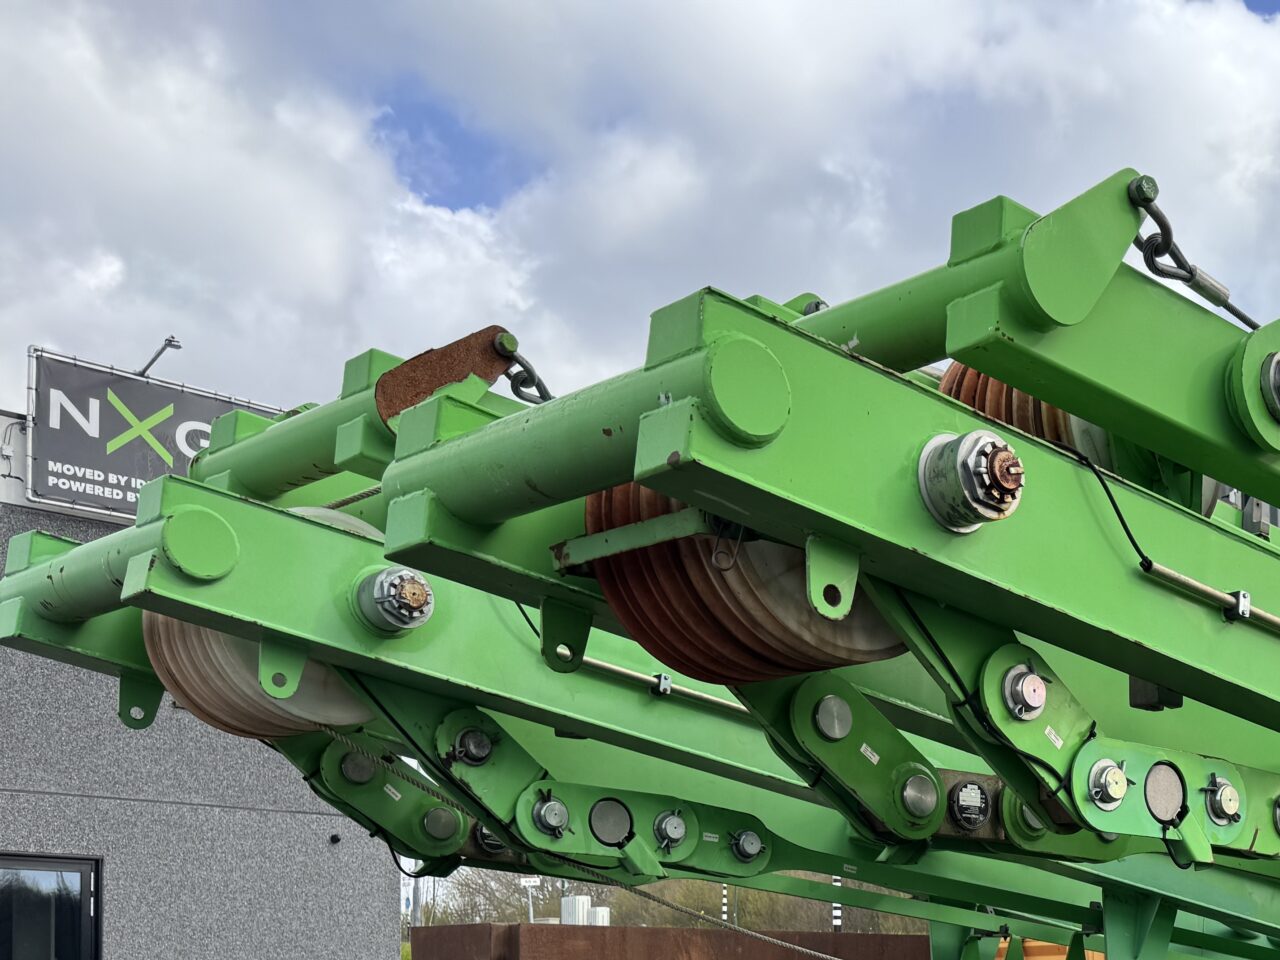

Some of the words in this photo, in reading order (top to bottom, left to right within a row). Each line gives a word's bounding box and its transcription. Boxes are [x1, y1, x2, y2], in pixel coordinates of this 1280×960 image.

[48, 460, 105, 481] MOVED
[108, 473, 128, 486] BY
[131, 477, 149, 489] ID
[48, 475, 123, 500] POWERED
